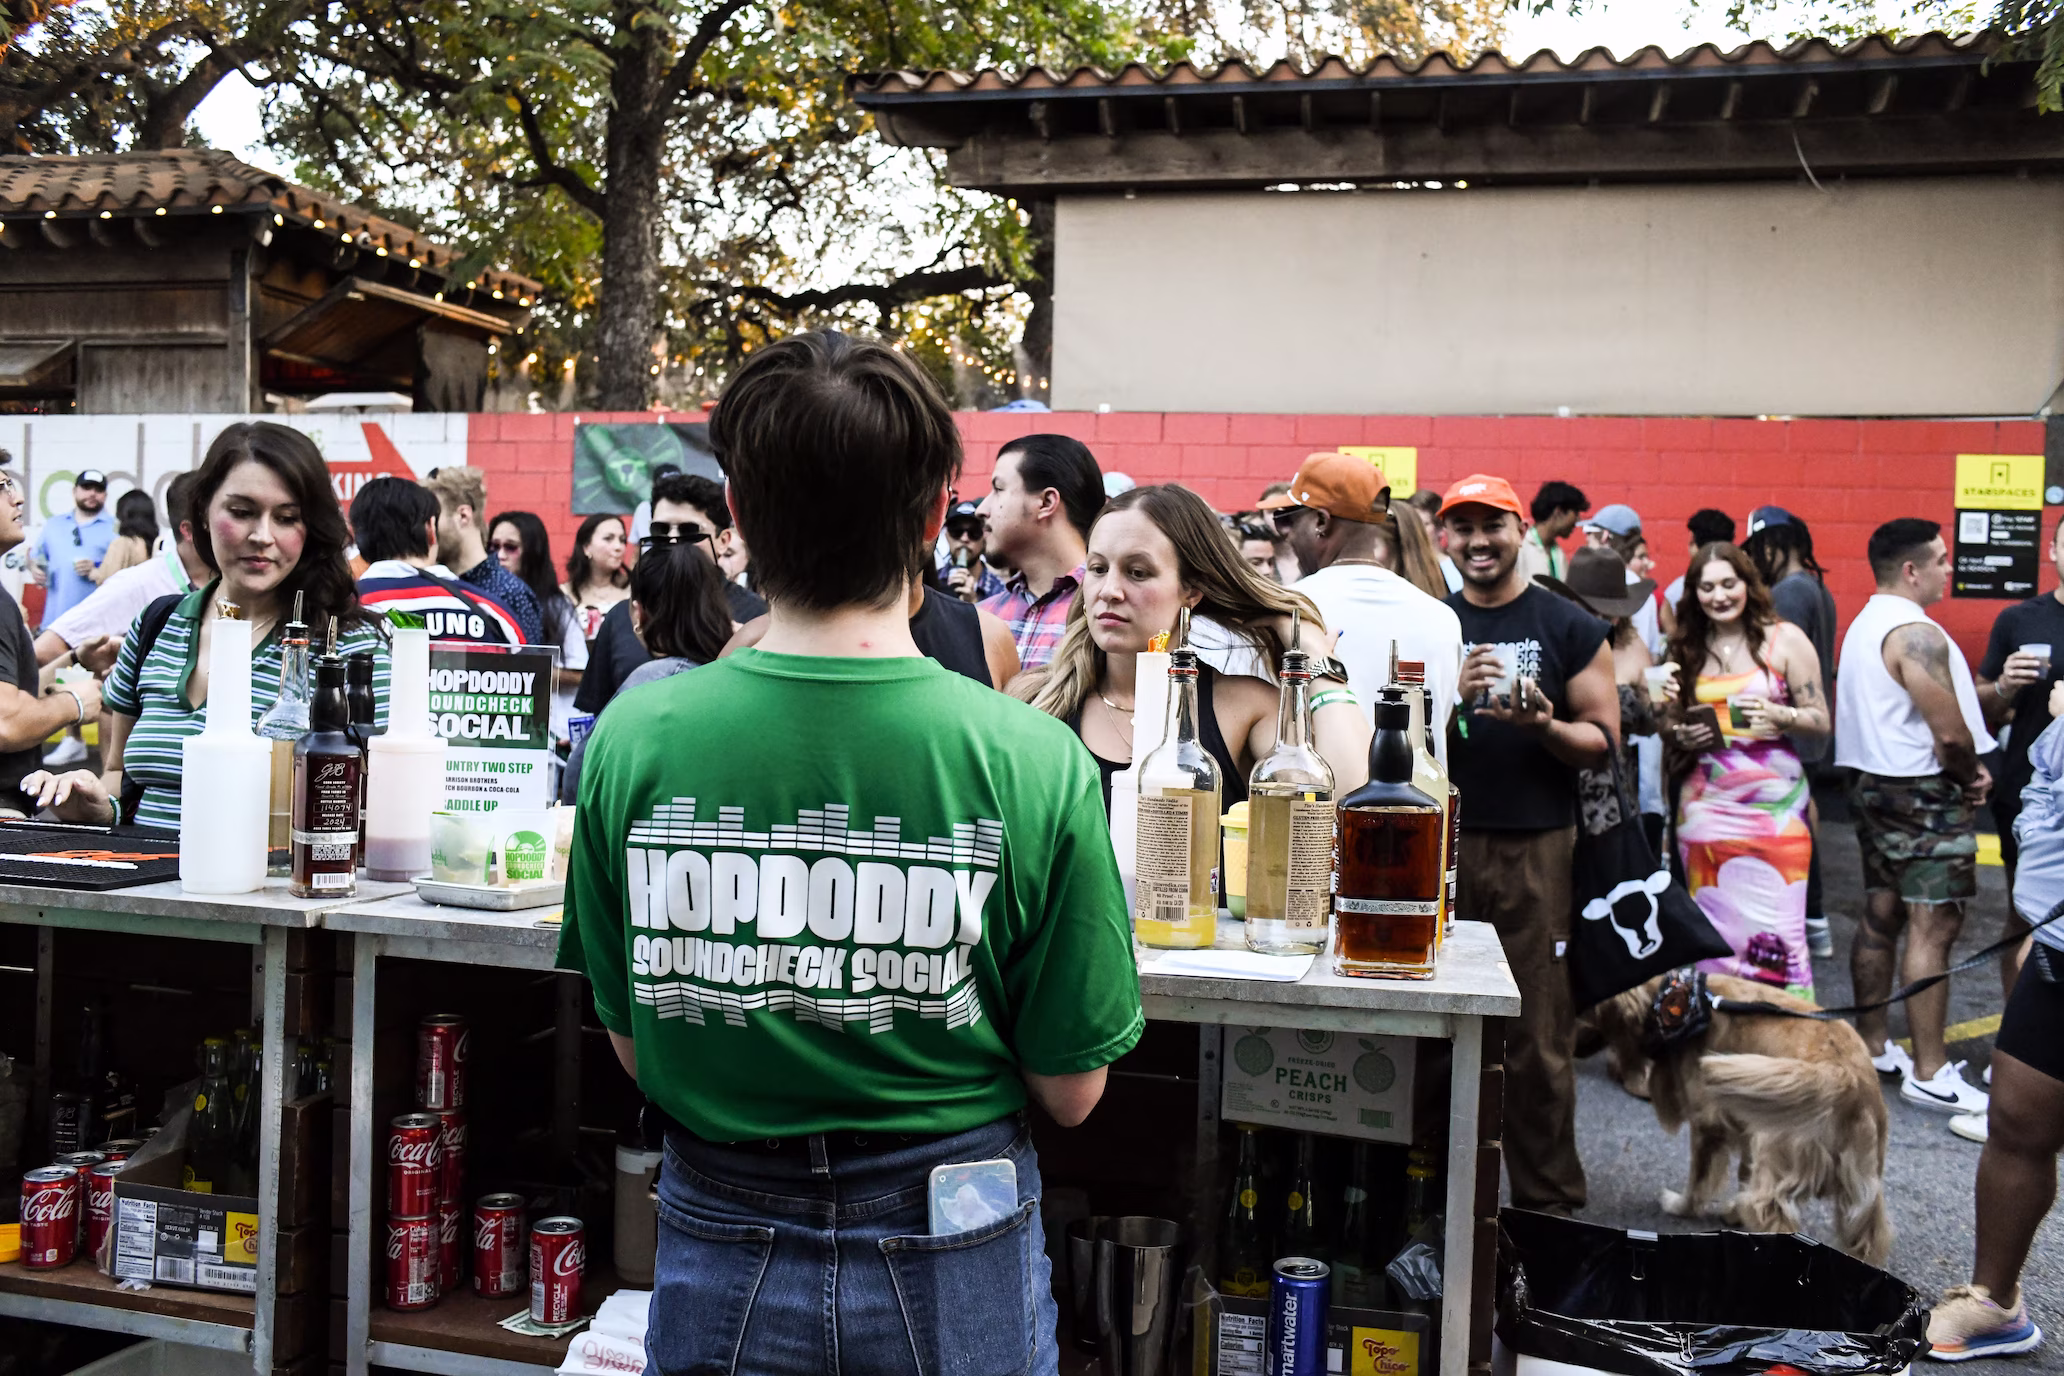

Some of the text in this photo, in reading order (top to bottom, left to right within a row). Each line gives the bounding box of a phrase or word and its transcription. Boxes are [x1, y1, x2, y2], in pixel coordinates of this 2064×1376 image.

[331, 472, 392, 500] KIN
[1963, 488, 2036, 497] STARSPACES
[482, 761, 505, 773] TWO
[508, 762, 533, 774] STEP
[489, 786, 520, 794] COCA-COLA
[445, 799, 499, 812] ADDLE UP
[323, 817, 346, 827] 2024
[507, 869, 544, 879] SOCIAL
[627, 848, 998, 949] HOPDODDY
[632, 934, 973, 994] SOUNDCHECK SOCIAL
[1288, 1056, 1336, 1068] FREEZE-DRIED
[1275, 1067, 1348, 1093] PEACH
[1289, 1089, 1332, 1104] CRISPS
[143, 1201, 156, 1209] Facts
[553, 1283, 561, 1322] RECYCLE
[1220, 1341, 1262, 1351] Calories 0
[1362, 1338, 1400, 1357] Topo
[1374, 1355, 1411, 1374] Chico
